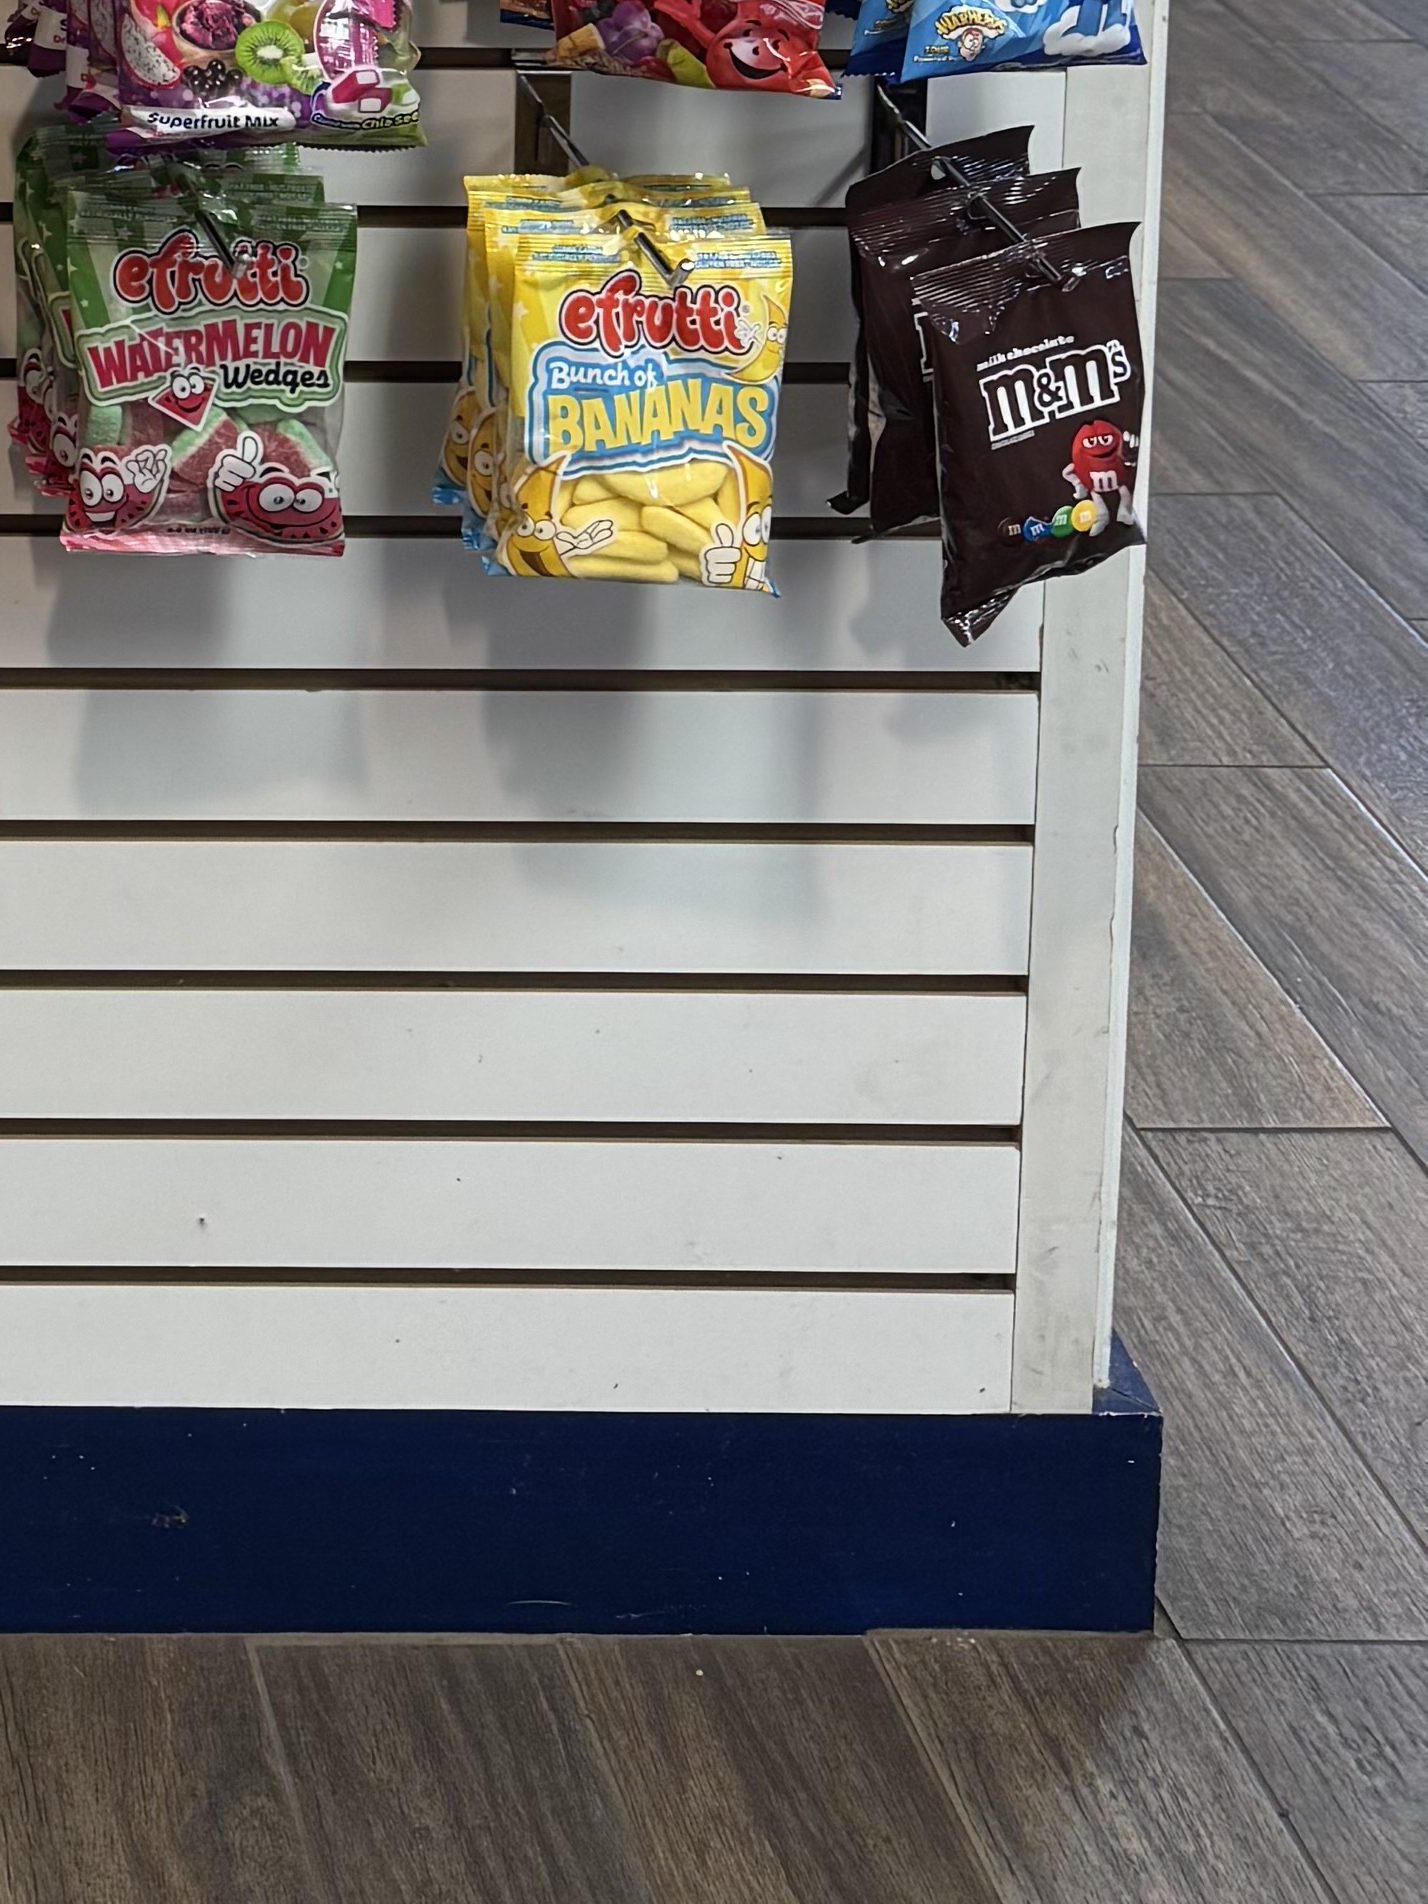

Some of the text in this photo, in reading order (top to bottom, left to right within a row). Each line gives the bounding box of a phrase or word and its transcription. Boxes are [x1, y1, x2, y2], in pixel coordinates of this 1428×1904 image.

[147, 111, 280, 131] Superfruit Mix
[116, 231, 307, 314] efrutti
[561, 270, 746, 357] efrutti
[88, 319, 338, 391] WATERMELON
[219, 362, 331, 394] Wedges
[549, 361, 659, 391] Bunch of
[976, 333, 1075, 372] milk chocolate
[547, 377, 771, 456] BANANAS
[979, 338, 1132, 442] m&m's
